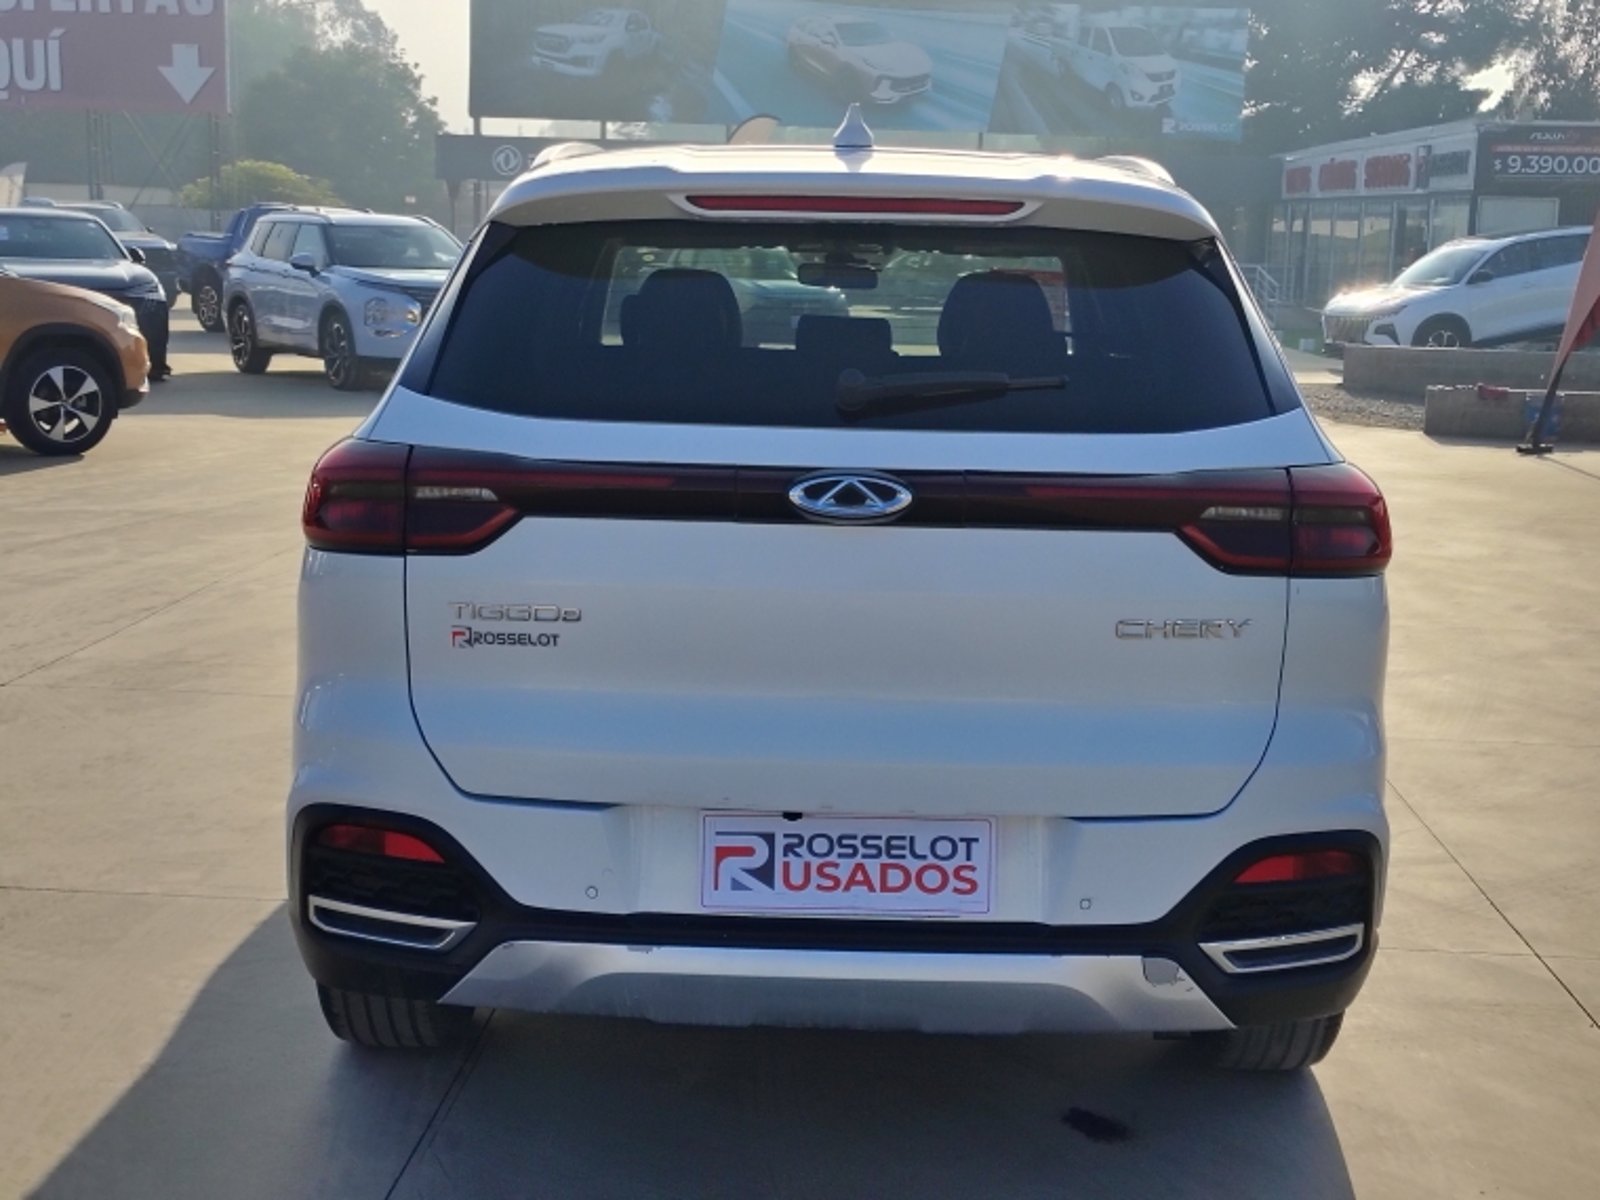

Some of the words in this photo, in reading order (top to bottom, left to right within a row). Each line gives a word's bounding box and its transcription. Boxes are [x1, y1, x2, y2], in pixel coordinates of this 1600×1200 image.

[473, 631, 559, 647] ROSSELOT
[1115, 618, 1252, 639] CHERY
[782, 833, 979, 862] ROSSELOT
[782, 861, 979, 896] USADOS
